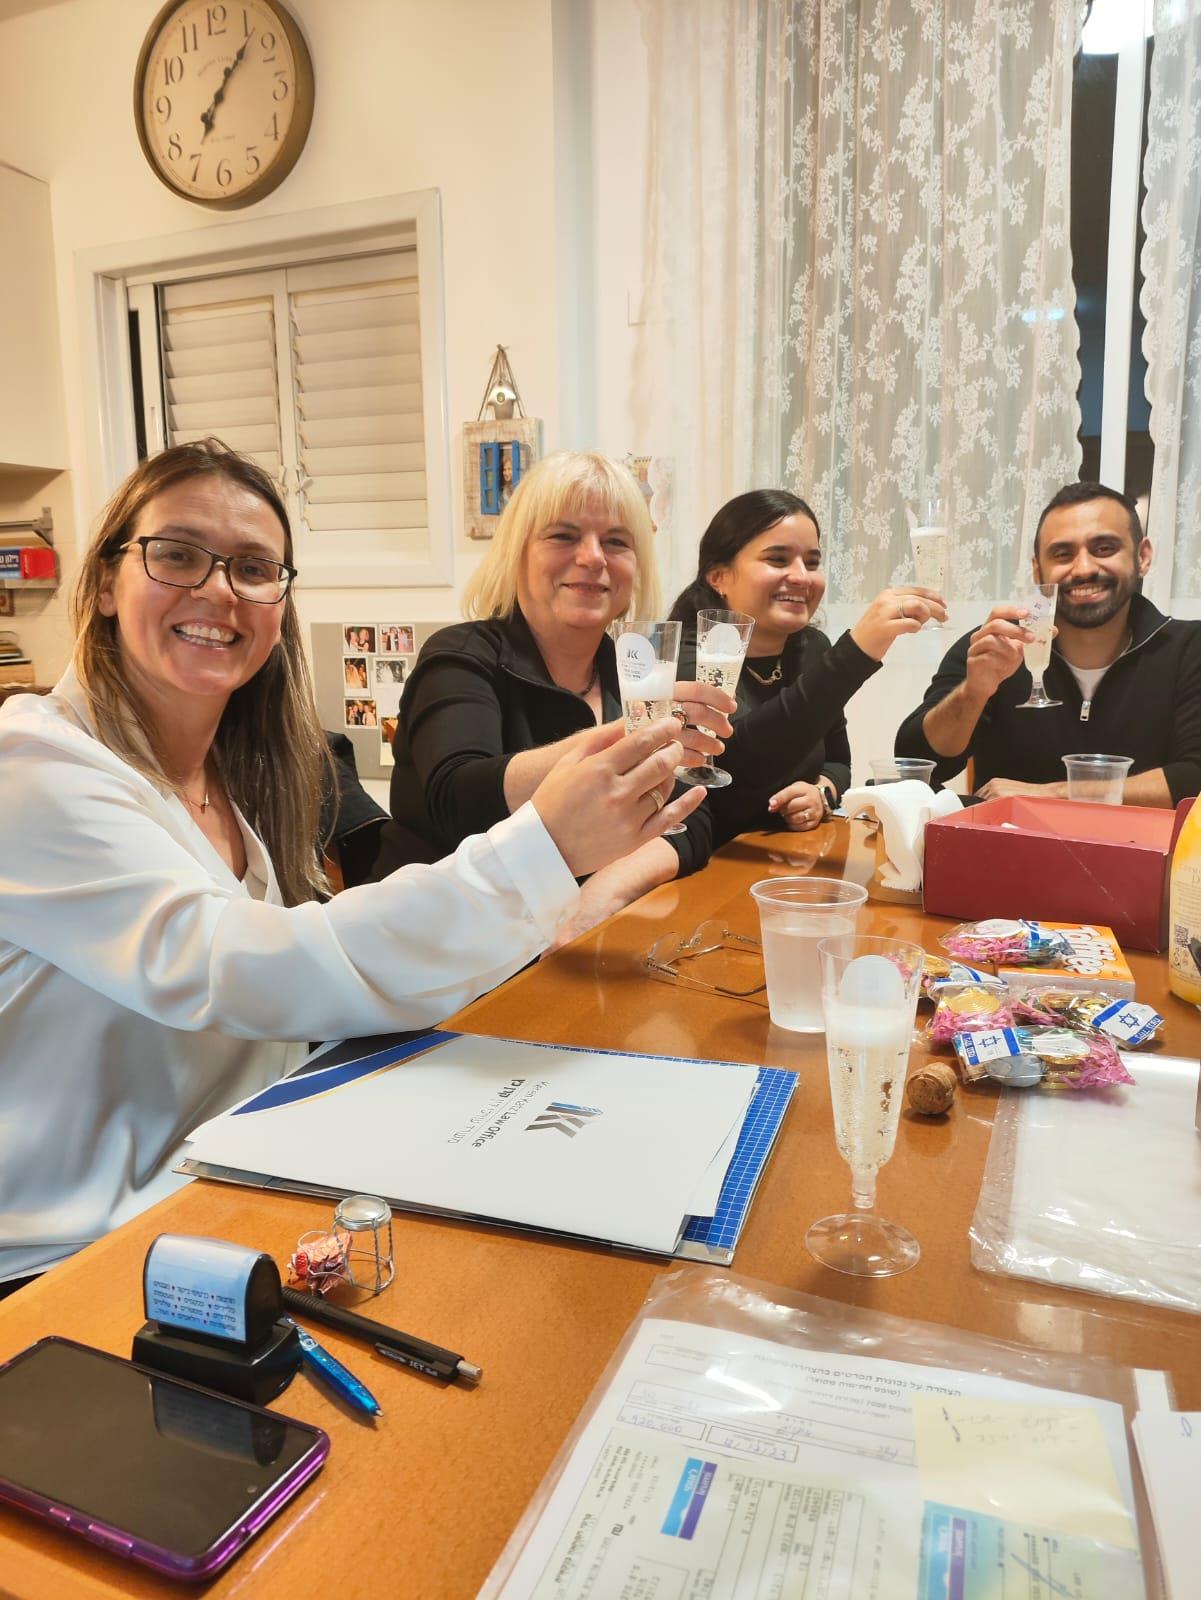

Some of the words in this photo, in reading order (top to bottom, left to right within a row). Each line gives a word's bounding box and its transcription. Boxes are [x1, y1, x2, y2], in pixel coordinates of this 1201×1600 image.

[207, 5, 226, 36] 12
[243, 9, 249, 37] 1
[182, 23, 199, 53] 11
[261, 32, 275, 63] 2
[164, 56, 184, 85] 10
[272, 70, 288, 101] 3
[156, 95, 171, 124] 9
[264, 112, 279, 141] 4
[167, 132, 182, 161] 8
[246, 146, 260, 175] 5
[189, 153, 202, 182] 7
[216, 158, 232, 187] 6
[498, 1085, 514, 1099] קרן
[511, 1079, 526, 1088] כץ
[495, 1110, 514, 1126] Law
[471, 1124, 501, 1148] Office
[833, 1369, 873, 1382] הפרטים
[909, 1381, 923, 1390] על
[925, 1384, 962, 1397] הצהרה
